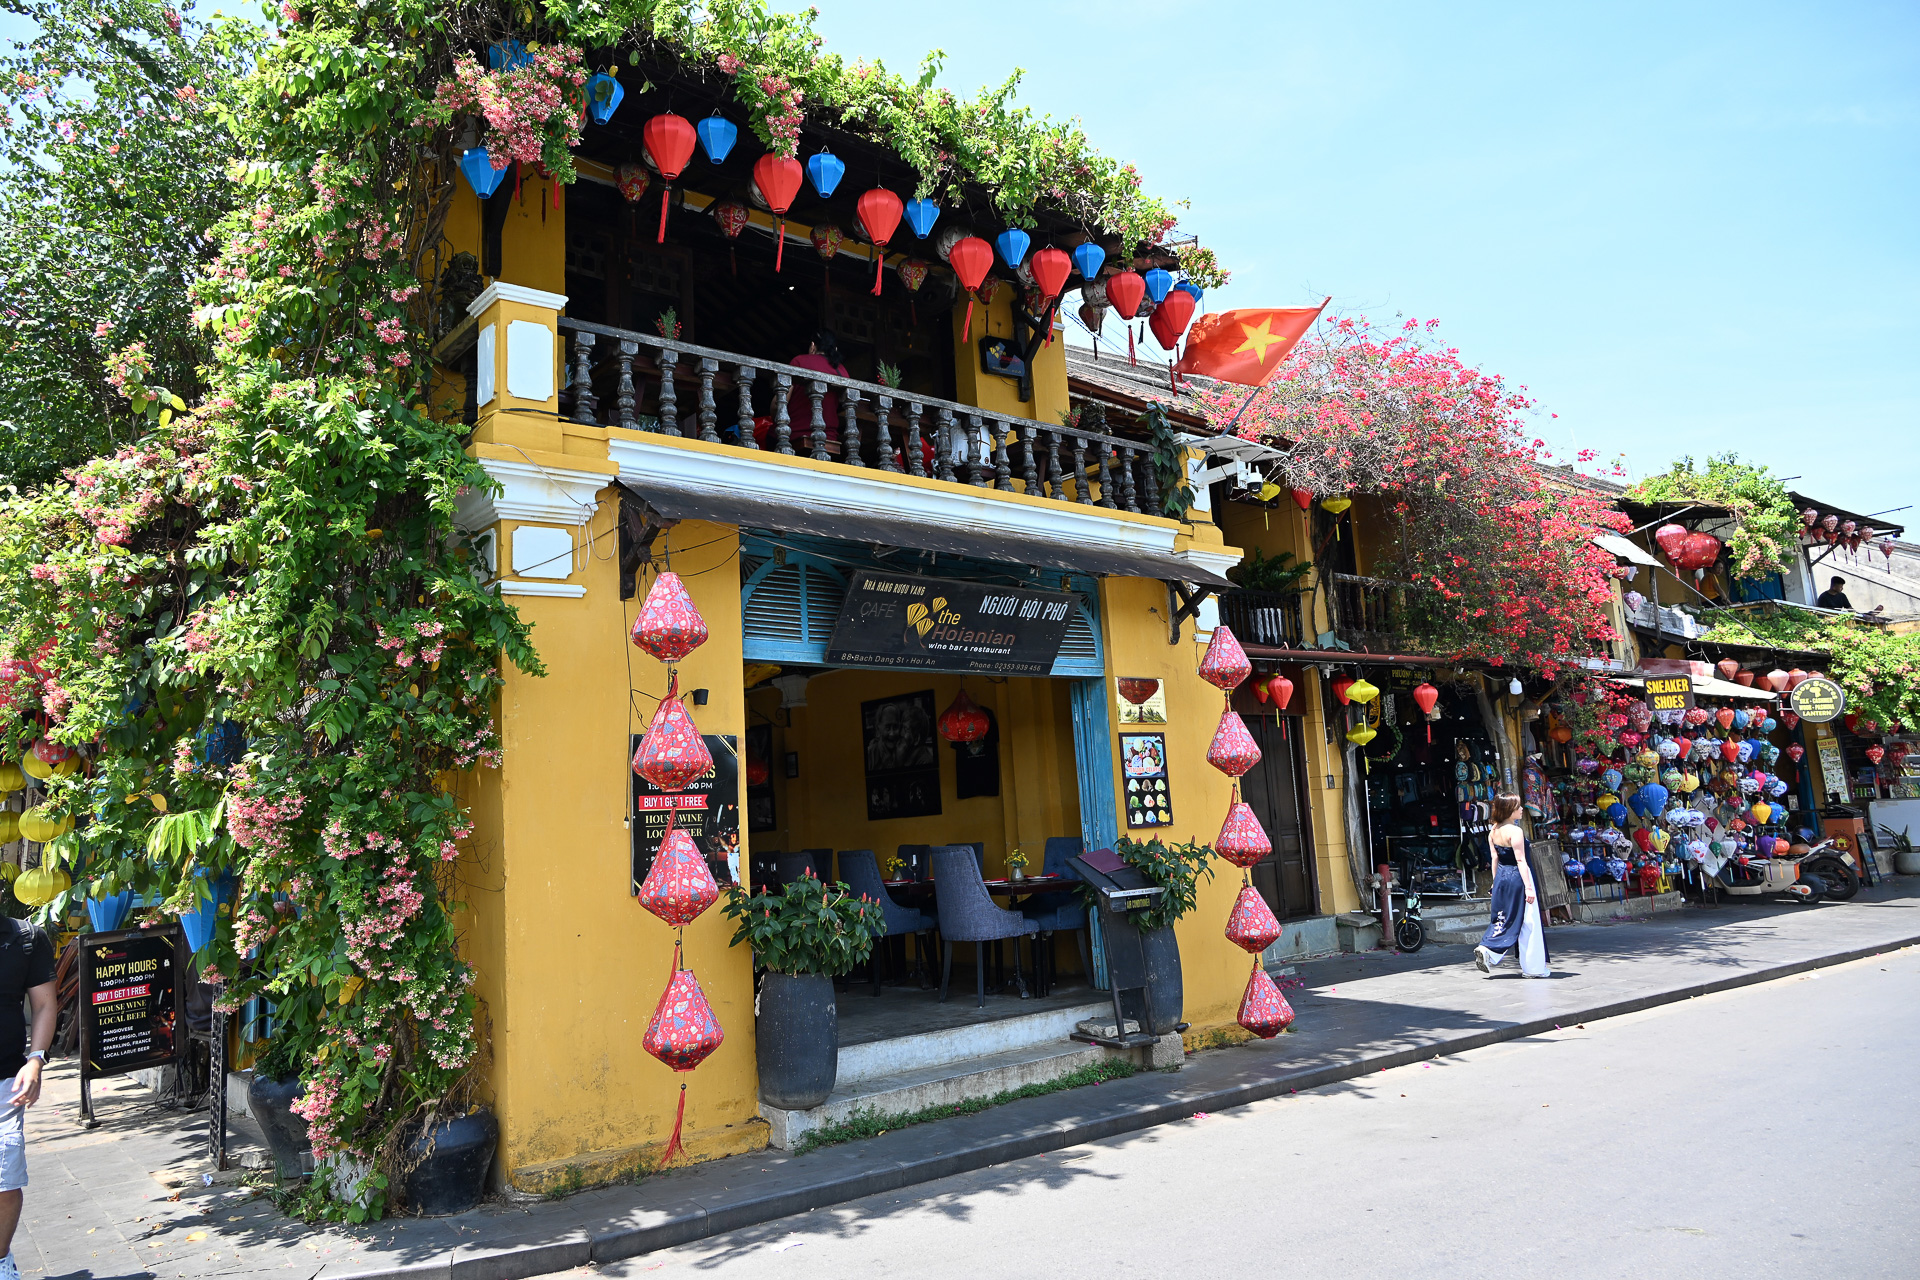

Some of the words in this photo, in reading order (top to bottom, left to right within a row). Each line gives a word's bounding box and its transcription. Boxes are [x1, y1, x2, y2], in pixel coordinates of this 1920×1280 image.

[909, 585, 926, 596] VANG
[860, 600, 898, 618] CAFÉ
[1019, 598, 1043, 621] HỘI
[938, 608, 961, 625] the
[931, 625, 1016, 646] Hoianian
[928, 642, 948, 650] wine
[948, 643, 963, 651] bar
[969, 646, 1011, 655] restaurant
[853, 654, 873, 662] Bach
[874, 655, 894, 664] Dang
[895, 656, 904, 664] St
[910, 657, 924, 665] Hoi
[1646, 678, 1689, 694] SNEAKER
[1793, 683, 1811, 701] Shop
[1654, 694, 1685, 709] SHOES
[700, 782, 713, 790] PM
[643, 797, 658, 808] BUY
[660, 797, 663, 807] 1
[680, 797, 683, 806] 1
[684, 796, 702, 807] FREE
[645, 814, 670, 824] HOUS
[679, 813, 703, 823] WINE
[96, 963, 126, 979] HAPPY
[128, 958, 157, 974] HOURS
[129, 975, 144, 983] 7:00
[96, 991, 109, 1002] BUY
[109, 991, 113, 999] 1
[114, 989, 125, 998] GET
[126, 988, 130, 996] 1
[131, 985, 146, 996] FREE
[98, 1003, 125, 1014] HOUSE
[126, 1000, 147, 1009] WINE
[99, 1015, 126, 1026] LOCAL
[126, 1011, 147, 1021] BEER
[103, 1025, 134, 1036] SANGIOVESE
[103, 1041, 132, 1051] SPARKLING,
[132, 1037, 152, 1046] FRANCE
